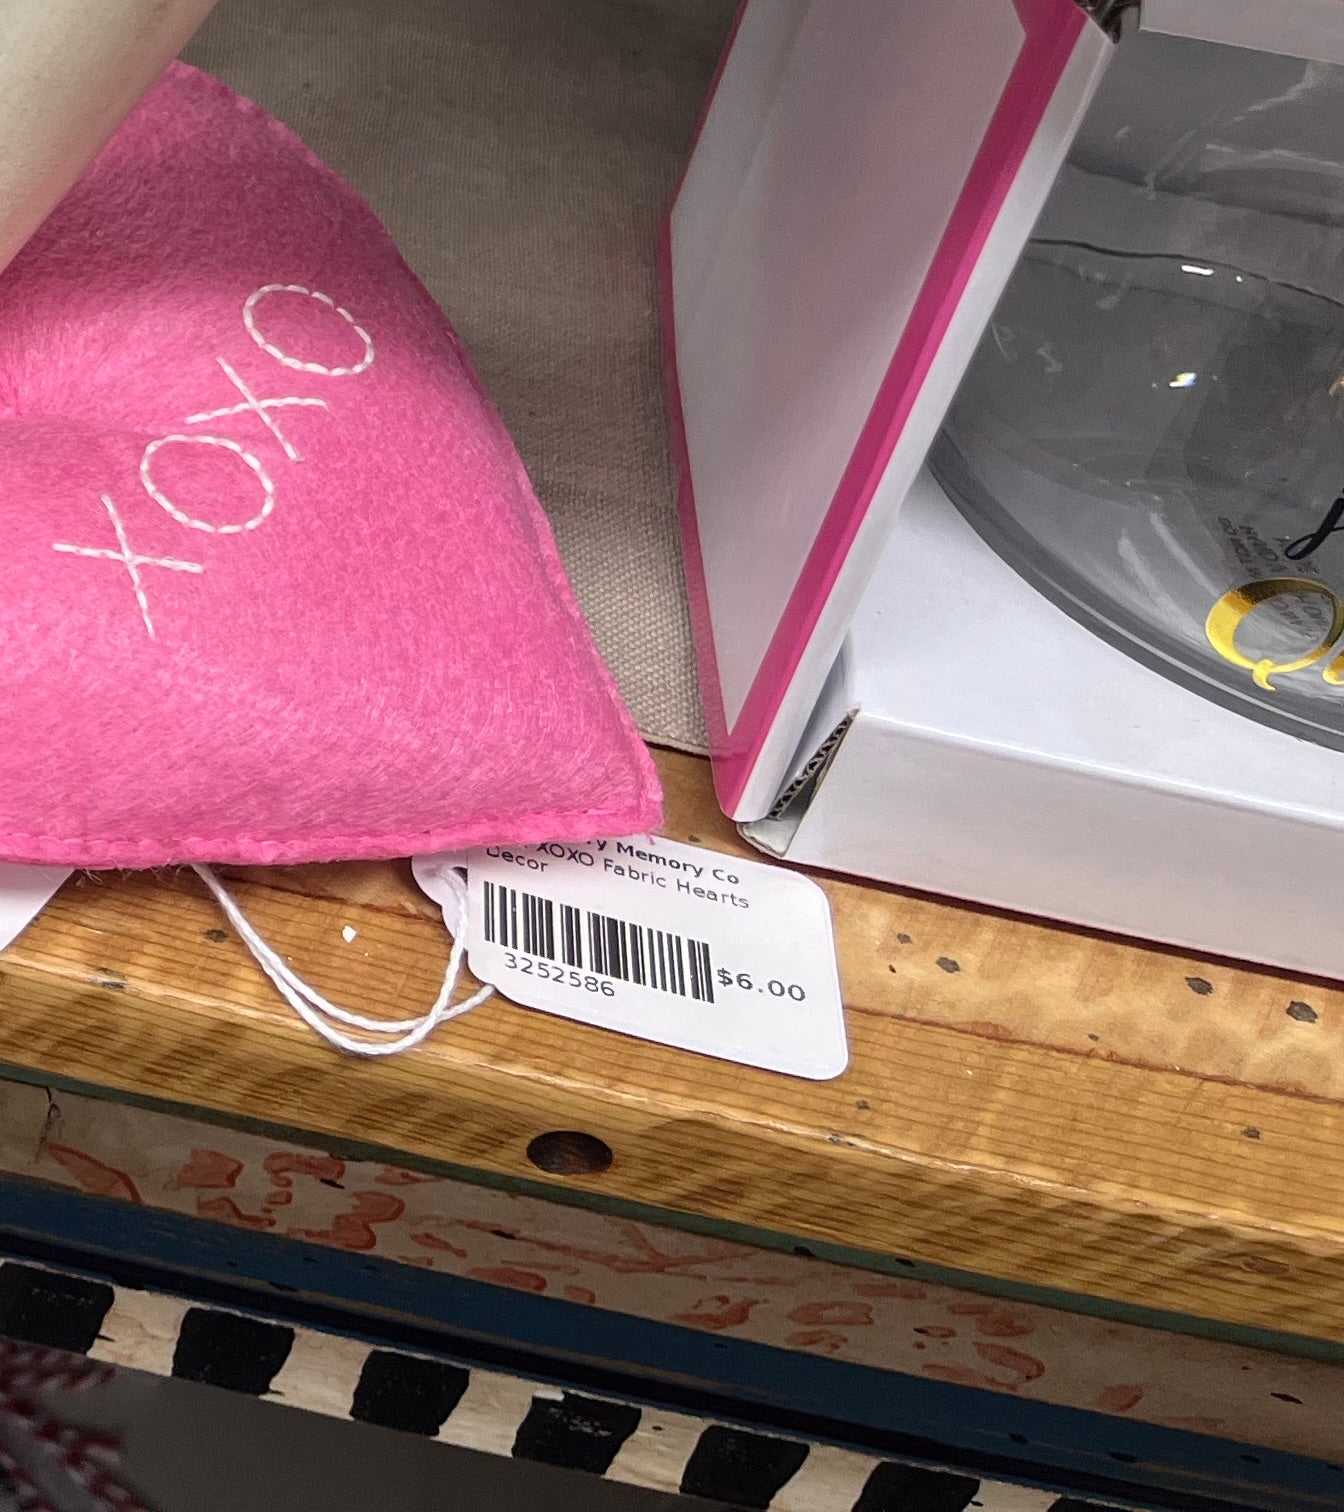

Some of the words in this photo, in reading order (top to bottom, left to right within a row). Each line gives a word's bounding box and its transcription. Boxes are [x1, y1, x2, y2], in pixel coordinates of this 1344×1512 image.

[52, 283, 376, 640] XOXO
[486, 846, 549, 873] Decor
[537, 842, 595, 868] XOXO
[603, 858, 668, 890] Fabric
[676, 878, 751, 911] Hearts
[616, 841, 705, 878] Memory
[712, 868, 740, 885] Co
[503, 951, 617, 999] 3252586
[716, 967, 807, 1004] $6.00
